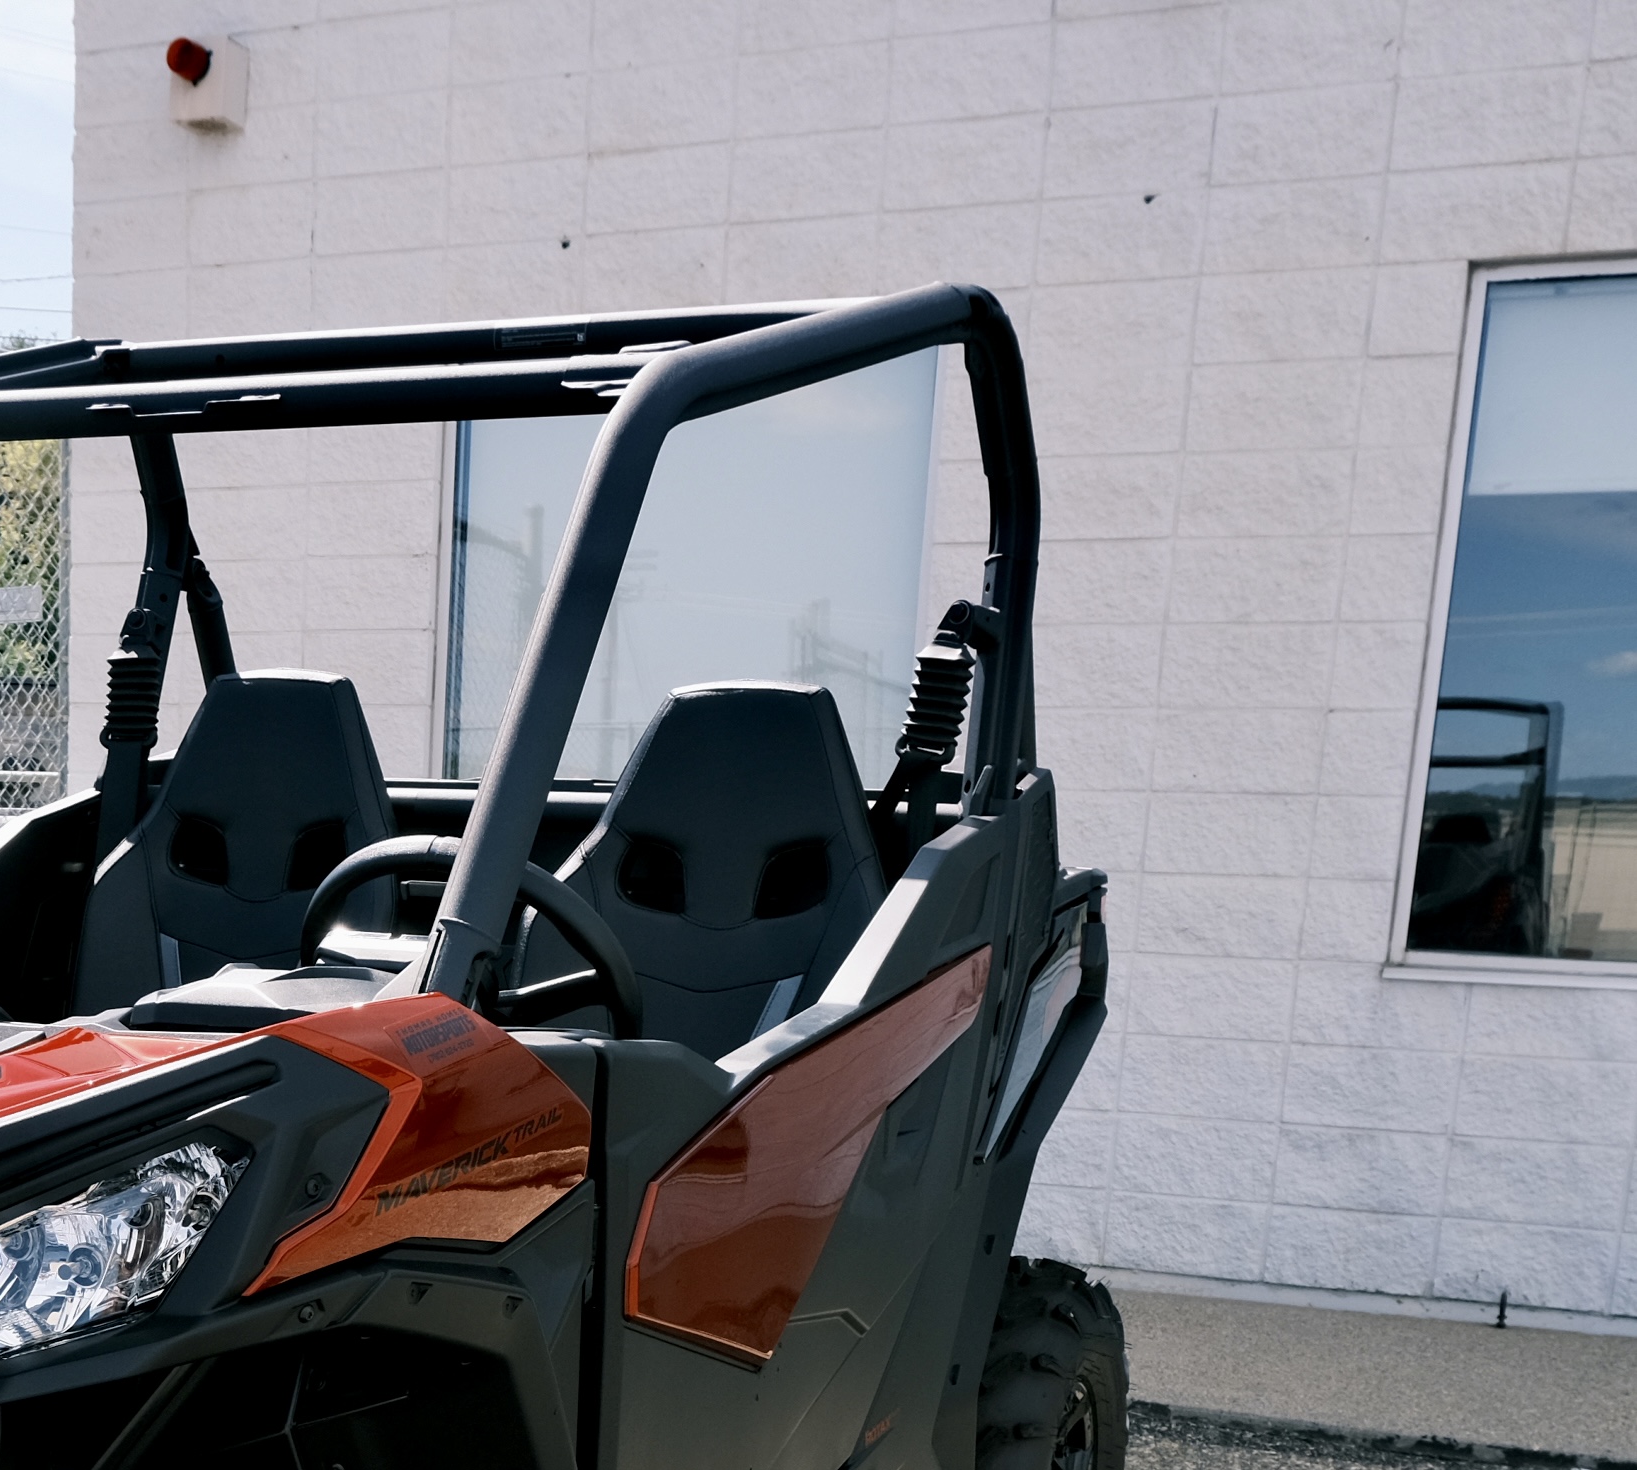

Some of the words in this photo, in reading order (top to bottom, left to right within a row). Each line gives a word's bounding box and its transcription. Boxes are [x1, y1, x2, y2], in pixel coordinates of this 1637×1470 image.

[395, 1018, 432, 1037] THOMAS
[401, 1014, 477, 1056] MOTORSPORTS
[375, 1132, 511, 1217] MAVERICK
[512, 1106, 563, 1143] TRAIL
